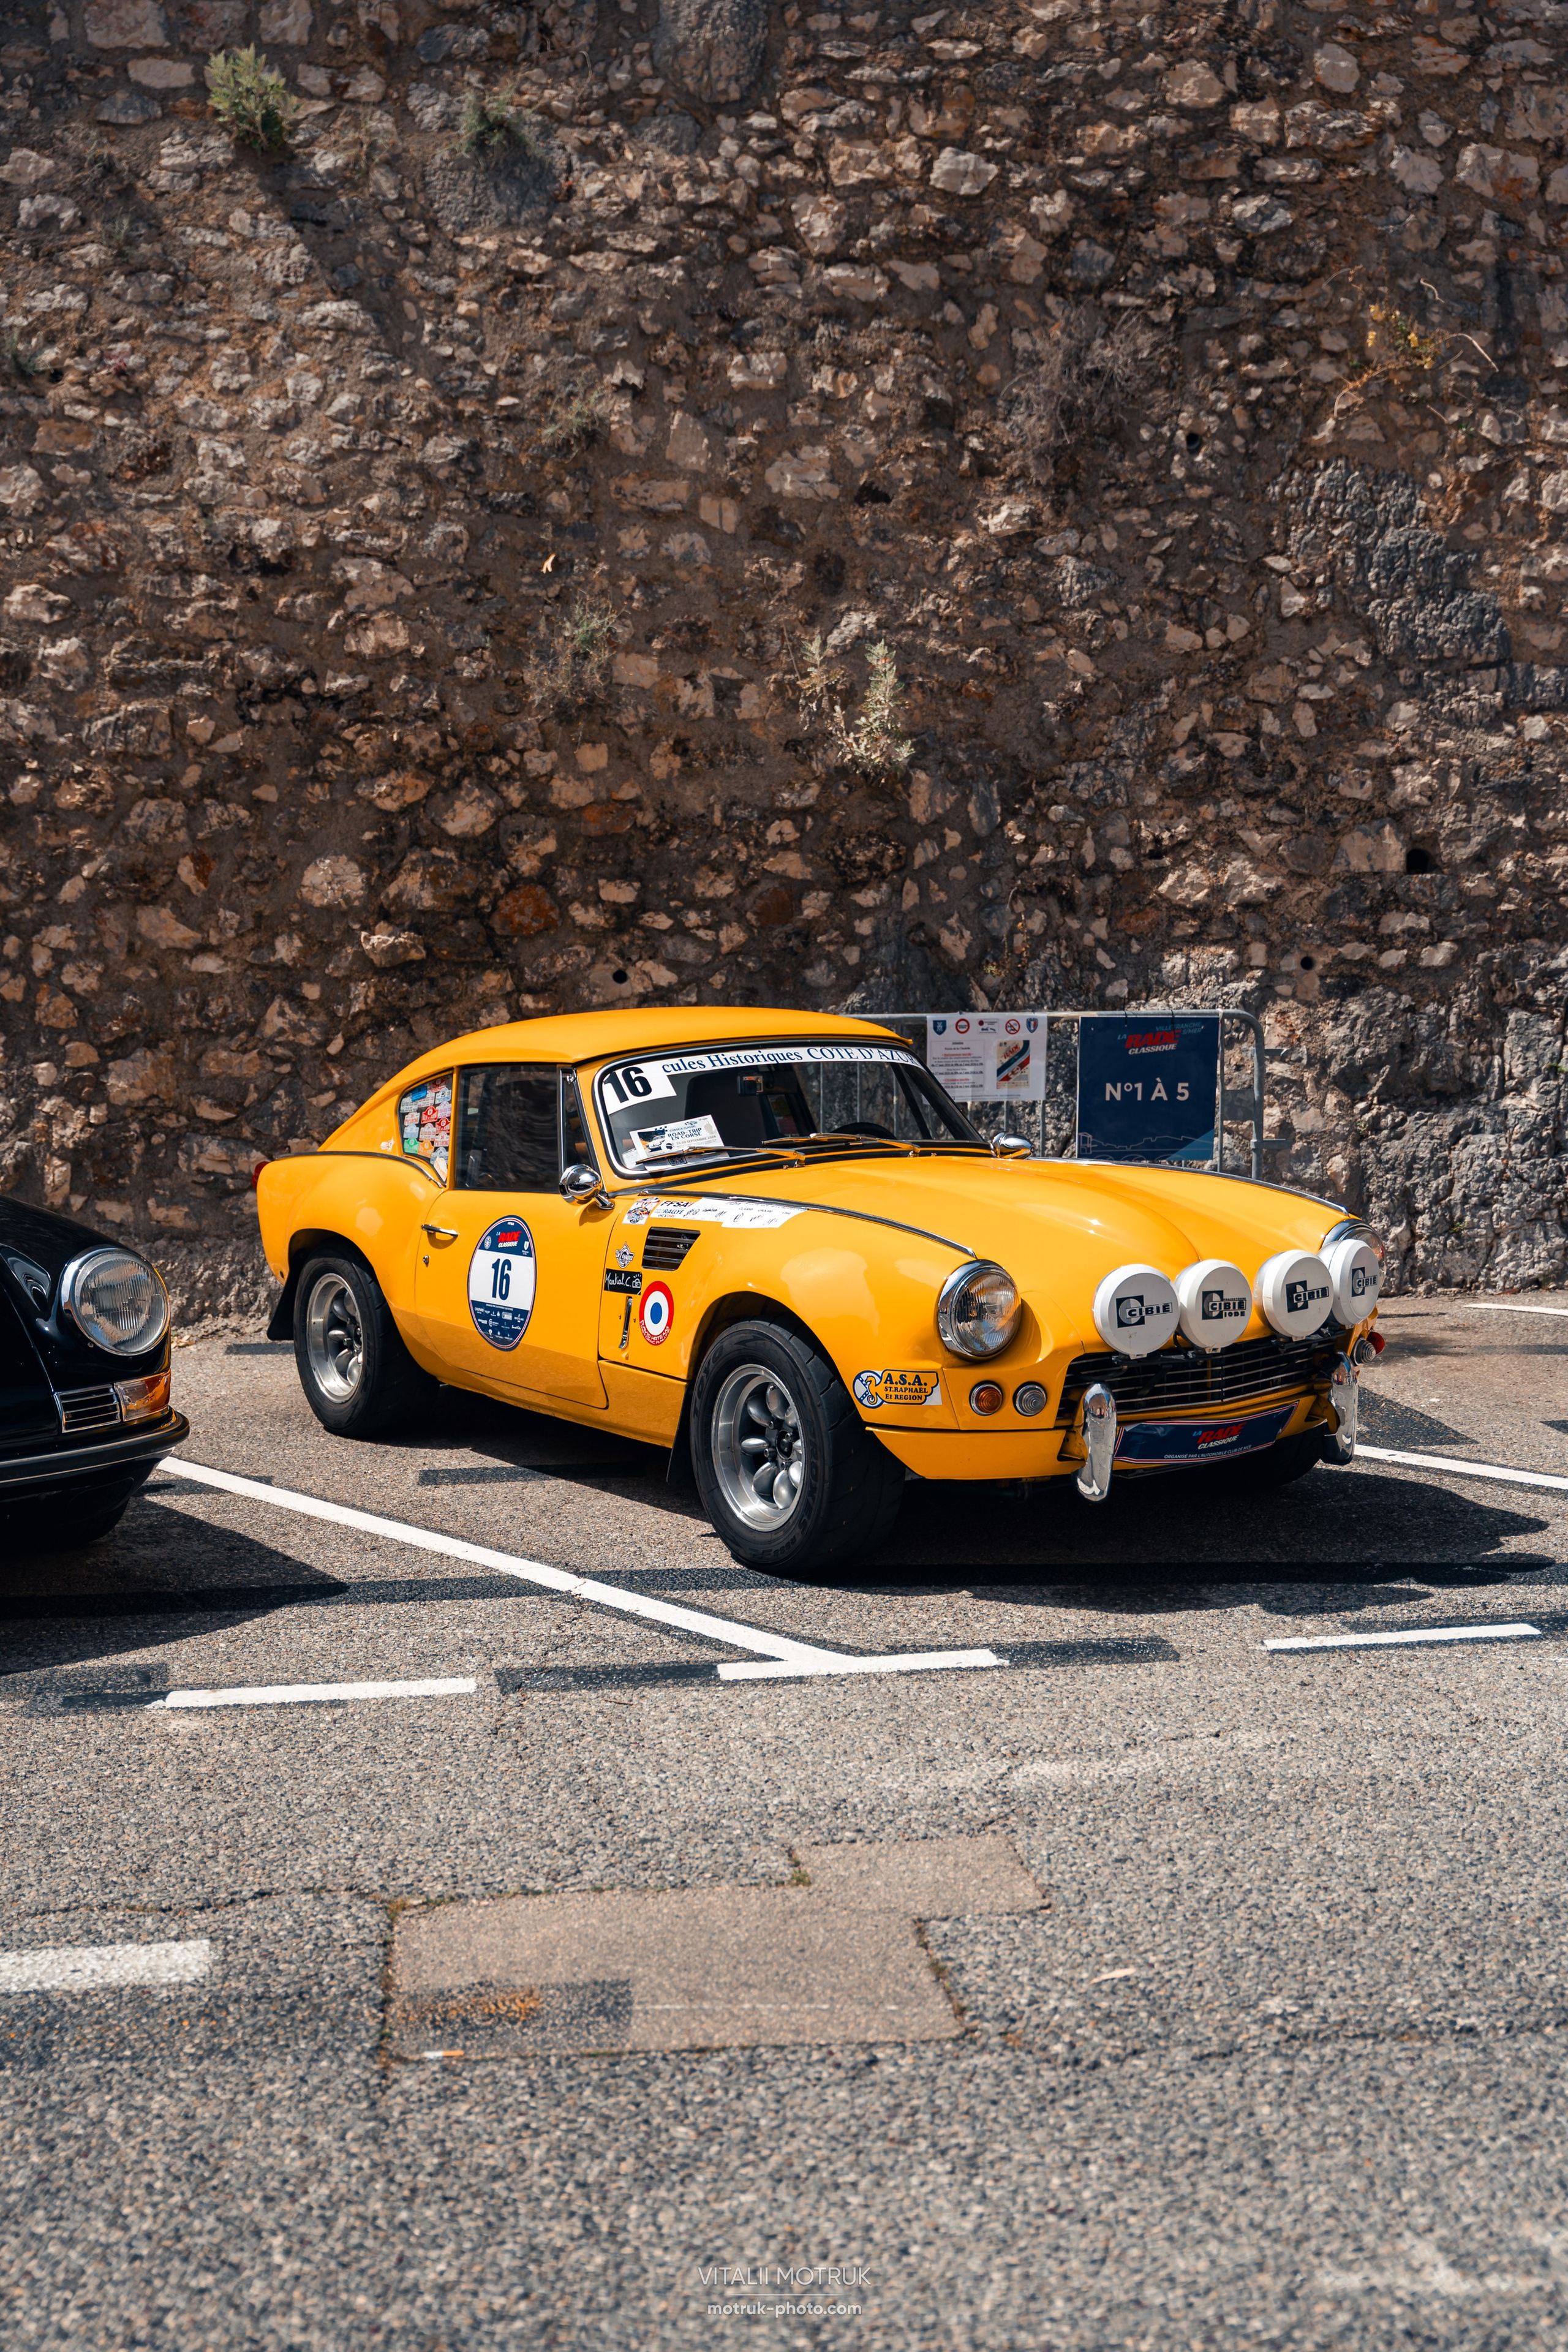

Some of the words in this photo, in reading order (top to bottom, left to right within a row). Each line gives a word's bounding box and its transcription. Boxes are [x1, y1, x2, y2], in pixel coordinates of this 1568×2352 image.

[1125, 1029, 1182, 1049] RADE
[1128, 1043, 1177, 1055] CLASSIQUE
[603, 1066, 652, 1104] 16
[706, 1050, 803, 1068] Historiques
[1150, 1077, 1168, 1101] À
[1176, 1082, 1189, 1101] 5
[667, 1127, 702, 1138] ROAD-TRIP
[497, 1231, 522, 1243] RADE
[491, 1258, 512, 1301] 16
[883, 1373, 928, 1386] A.S.A.
[1197, 1422, 1247, 1444] RADE
[1197, 1434, 1240, 1450] CLASSIQUE
